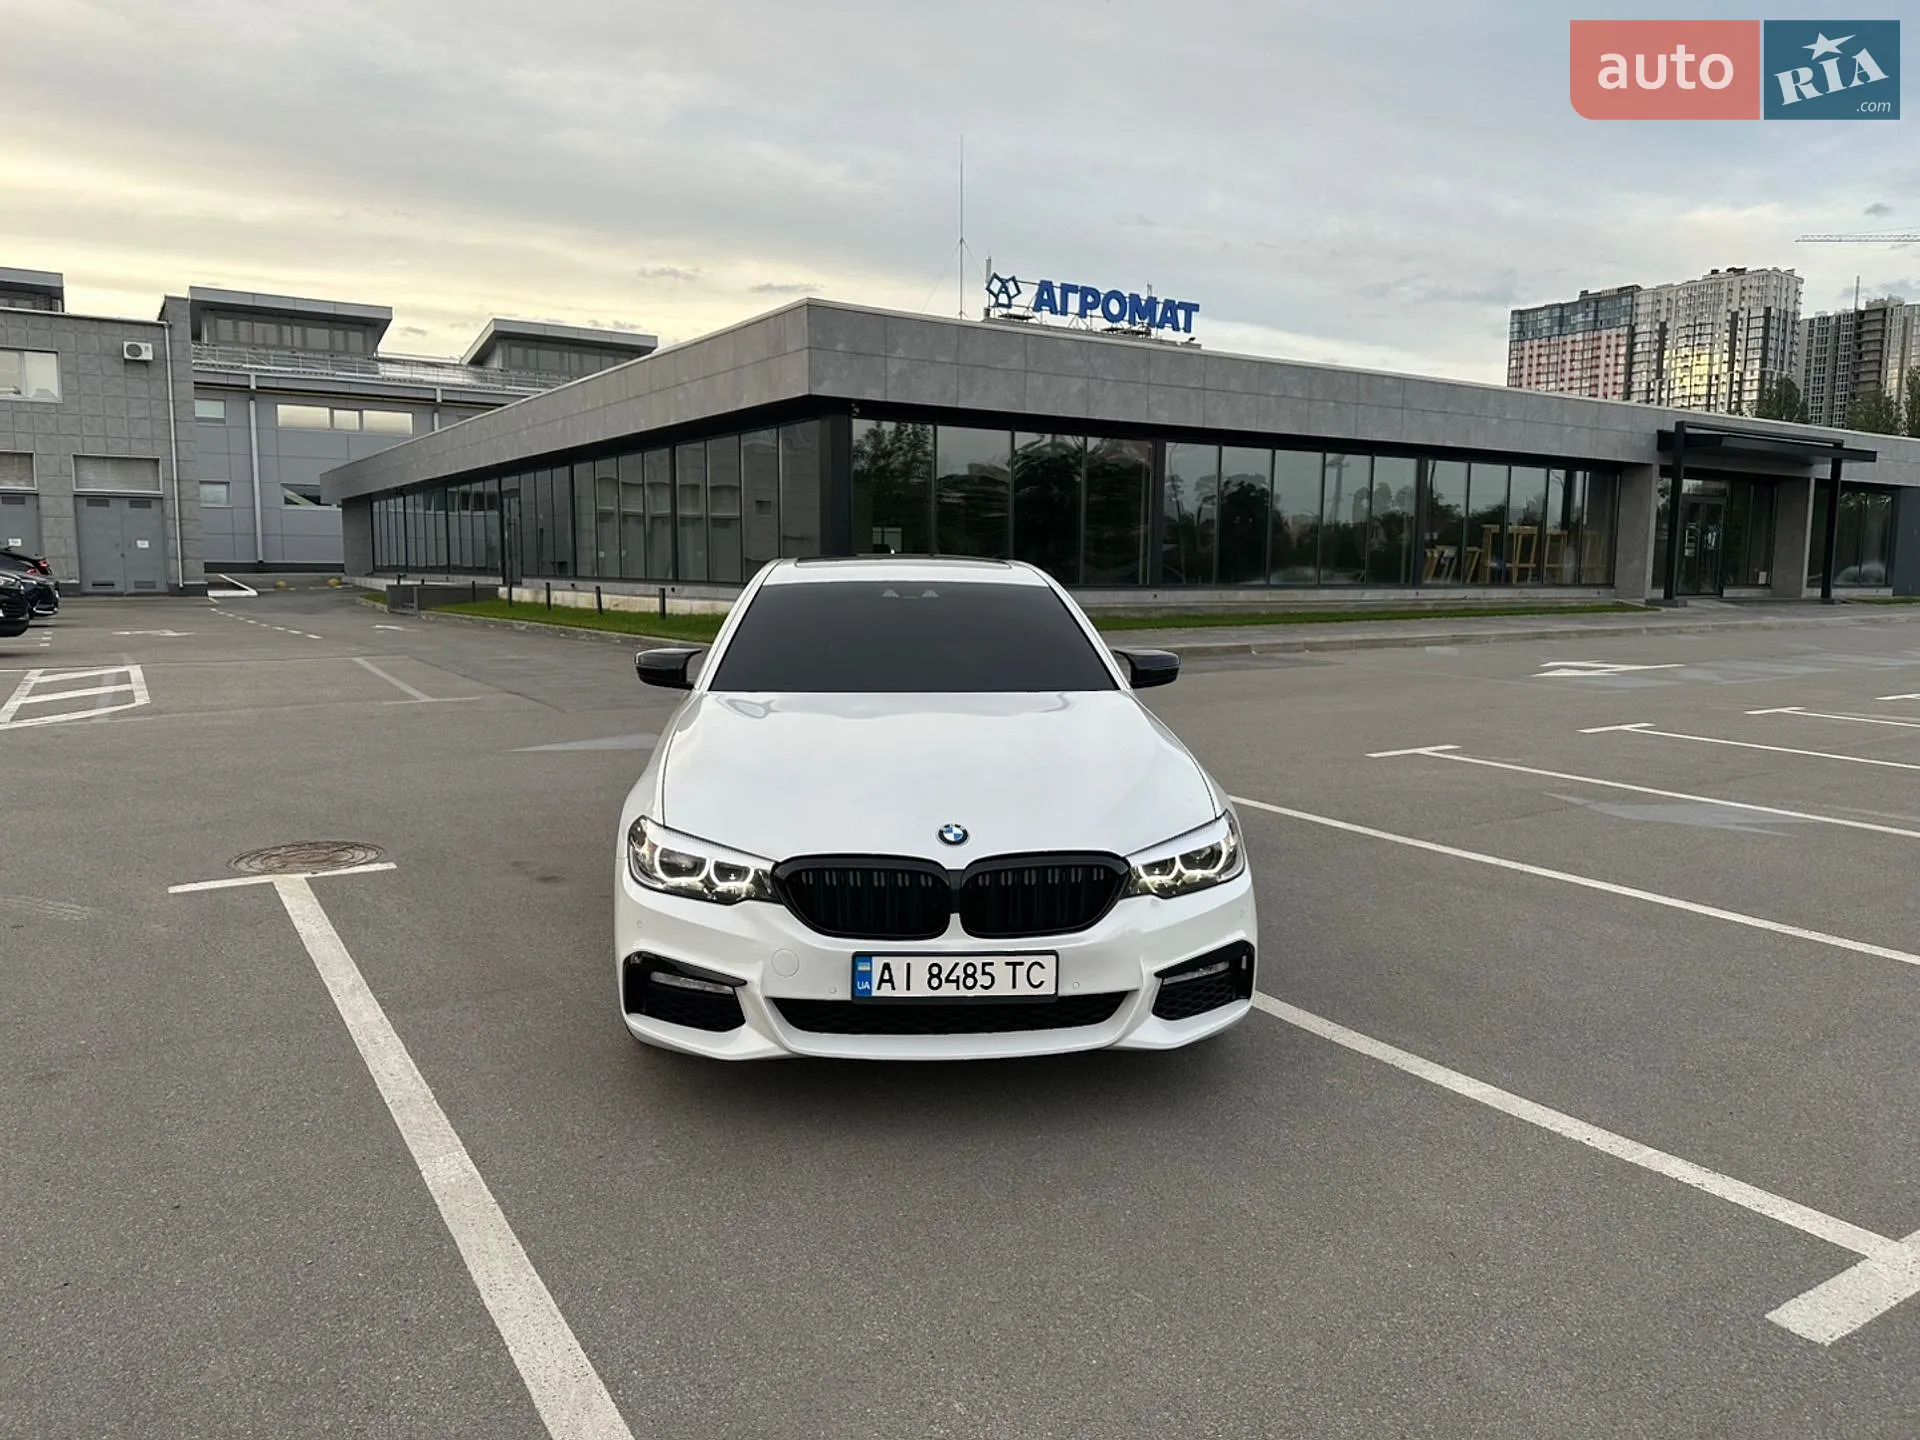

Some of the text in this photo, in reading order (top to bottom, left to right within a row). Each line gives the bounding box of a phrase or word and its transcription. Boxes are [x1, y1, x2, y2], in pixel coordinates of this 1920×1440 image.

[1033, 279, 1200, 333] АГРОМАТ
[857, 981, 870, 990] UA
[877, 961, 1046, 991] AI 8485 TC
